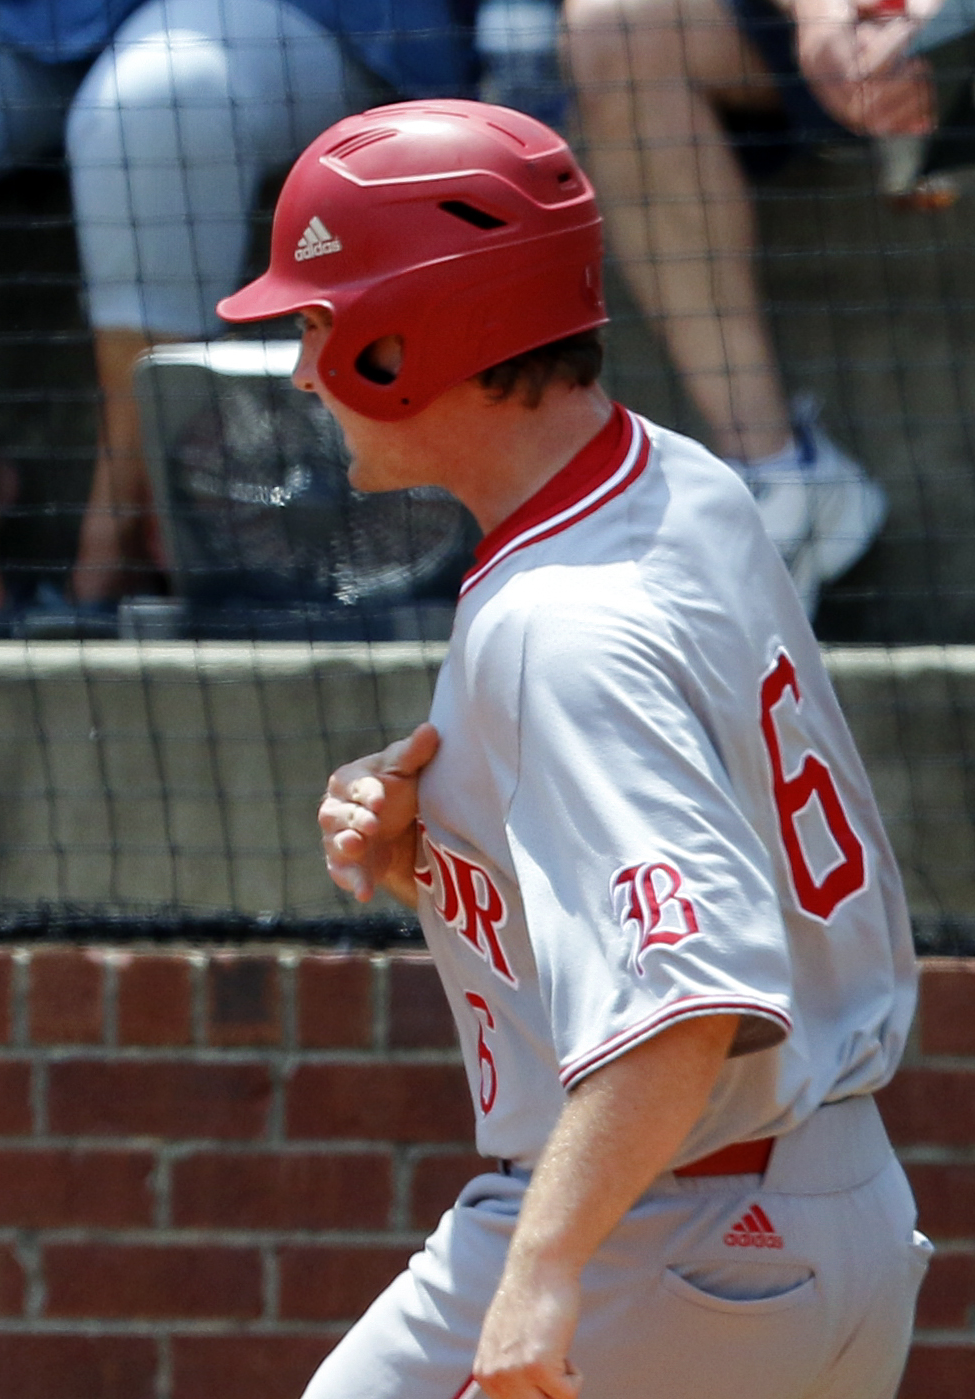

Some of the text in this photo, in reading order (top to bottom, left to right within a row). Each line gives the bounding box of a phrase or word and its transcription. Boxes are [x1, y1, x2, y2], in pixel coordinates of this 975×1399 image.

[294, 240, 343, 262] adidas
[757, 645, 870, 927] 6
[609, 862, 705, 979] B
[463, 989, 498, 1120] 6
[723, 1232, 784, 1250] adidas
